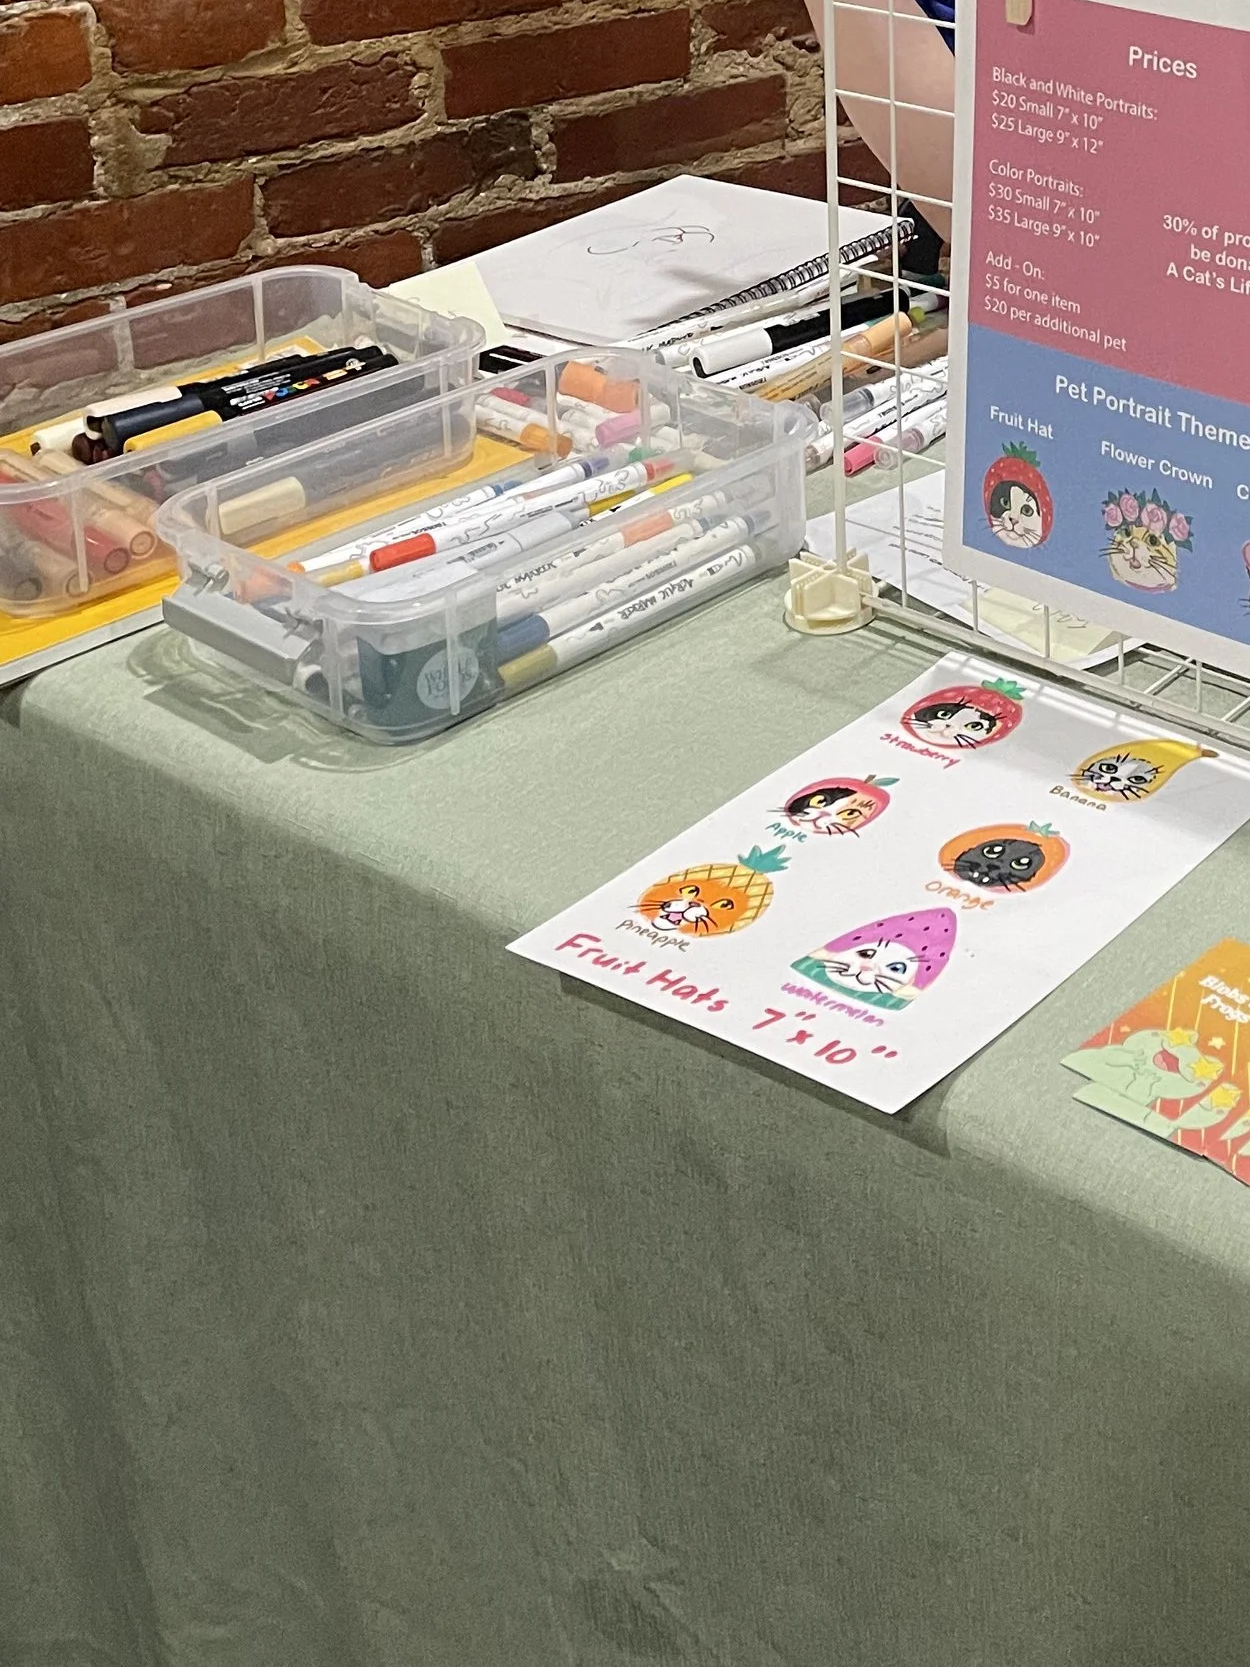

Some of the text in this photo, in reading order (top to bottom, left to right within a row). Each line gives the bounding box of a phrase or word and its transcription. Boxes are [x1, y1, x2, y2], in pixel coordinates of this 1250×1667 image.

[1128, 45, 1197, 79] Prices
[991, 88, 1016, 109] $20
[1018, 95, 1053, 118] Small
[1056, 105, 1070, 120] 7"
[1083, 112, 1103, 130] 10"
[992, 65, 1157, 120] Black and White Portraits:
[991, 111, 1015, 131] $25
[1017, 118, 1054, 143] Large
[1056, 129, 1071, 146] 9"
[1082, 136, 1104, 155] 12"
[988, 158, 1083, 197] Color Portraits:
[988, 181, 1012, 201] $30
[1014, 188, 1050, 211] Small
[1053, 198, 1066, 214] 7"
[1079, 206, 1100, 224] 10"
[987, 203, 1011, 224] $35
[1013, 211, 1050, 236] Large
[1052, 222, 1067, 238] 9"
[1079, 230, 1101, 248] 10"
[1162, 213, 1197, 236] 30%
[1200, 224, 1219, 240] of
[984, 250, 1012, 270] Add
[1022, 260, 1044, 280] On:
[1189, 242, 1211, 262] be
[984, 272, 1080, 314] $5 for one item
[1165, 261, 1178, 278] A
[1182, 265, 1225, 289] Cat's
[984, 294, 1127, 352] $20 per additional pet
[989, 404, 1054, 439] Fruit Hat
[1055, 374, 1250, 450] Pet Portrait Theme
[1100, 439, 1212, 489] Flower Crown
[1049, 784, 1107, 811] Banana
[765, 822, 807, 843] Apple
[554, 932, 647, 977] Fruit
[646, 968, 731, 1014] Hats
